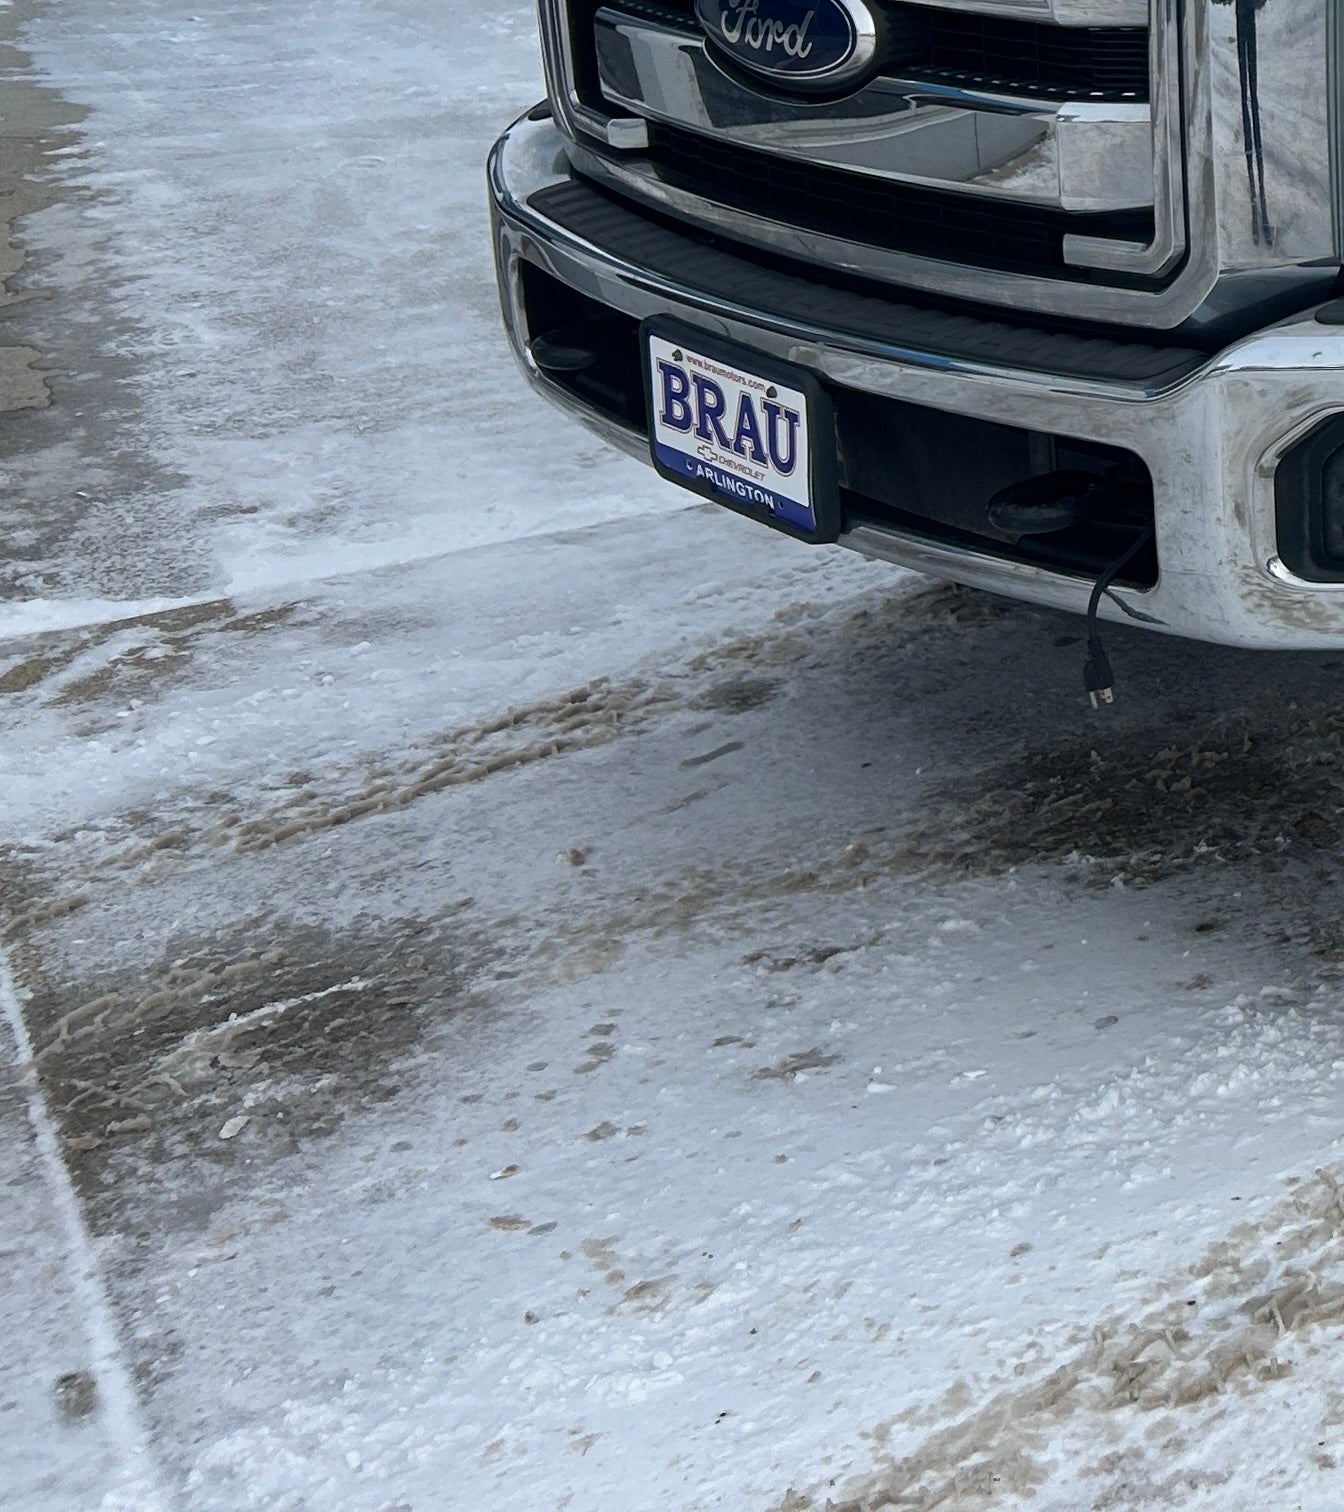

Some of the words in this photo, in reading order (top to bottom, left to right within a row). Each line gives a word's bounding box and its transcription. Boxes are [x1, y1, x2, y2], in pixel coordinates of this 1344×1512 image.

[686, 355, 766, 392] www.braumotors.com
[656, 357, 800, 478] BRAU
[696, 464, 775, 510] ARLINGTON
[718, 455, 766, 481] CHEVROLET
